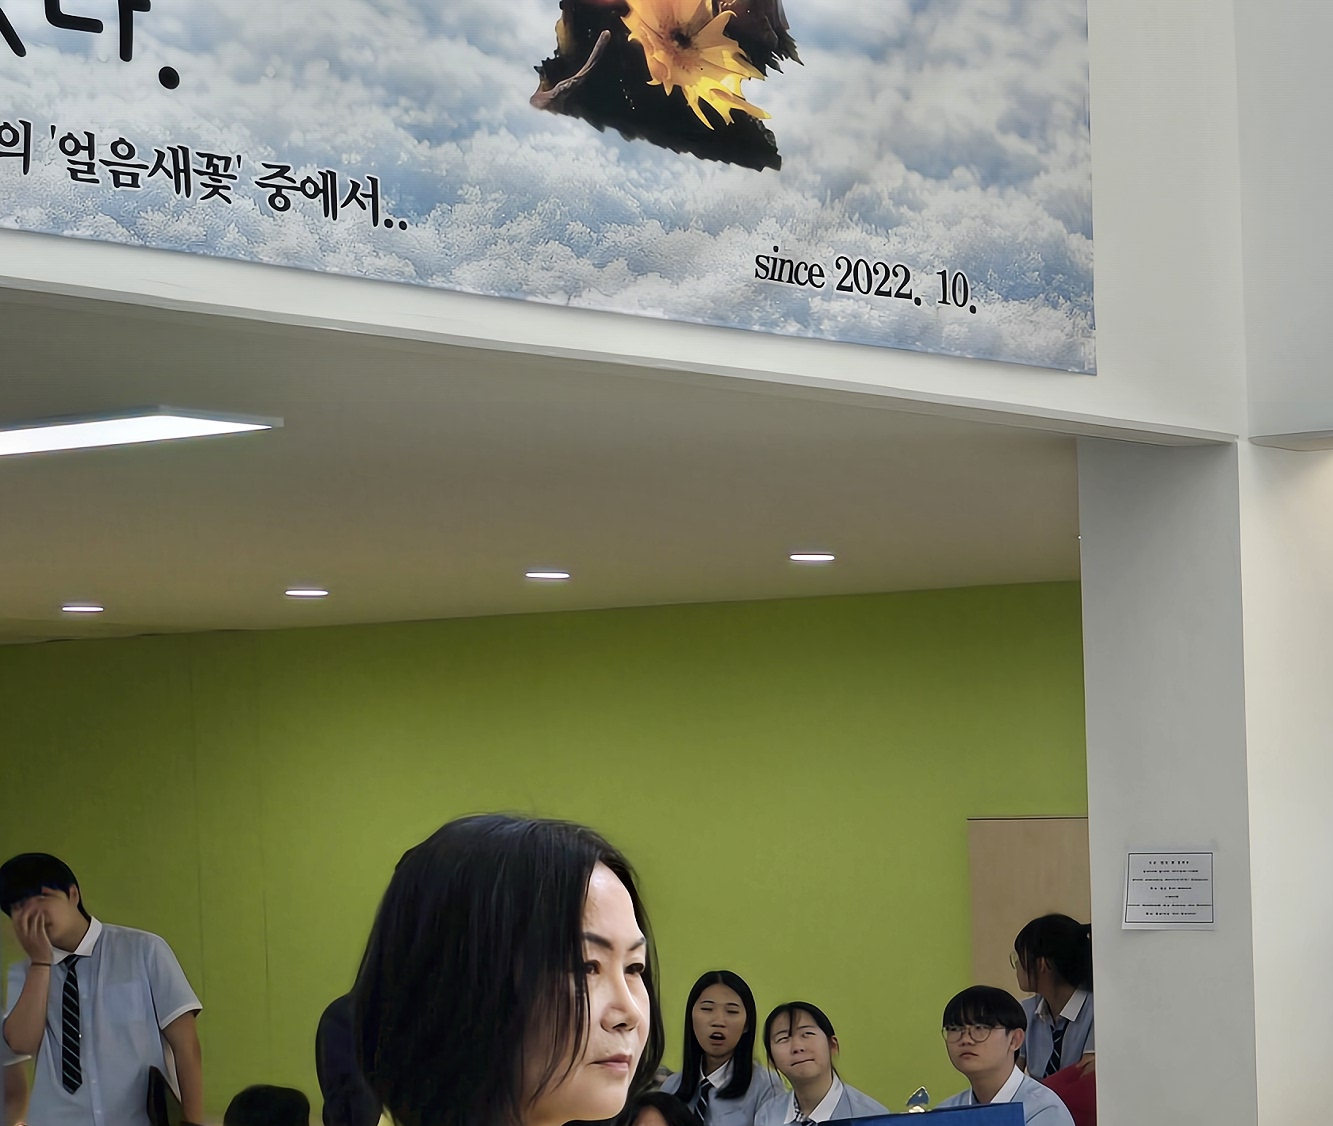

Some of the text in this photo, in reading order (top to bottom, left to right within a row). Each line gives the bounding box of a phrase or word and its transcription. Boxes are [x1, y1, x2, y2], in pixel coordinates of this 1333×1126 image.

[49, 125, 242, 204] '얼음새꽃'
[255, 161, 408, 230] 중에서..
[754, 245, 978, 314] since 2022. 10.
